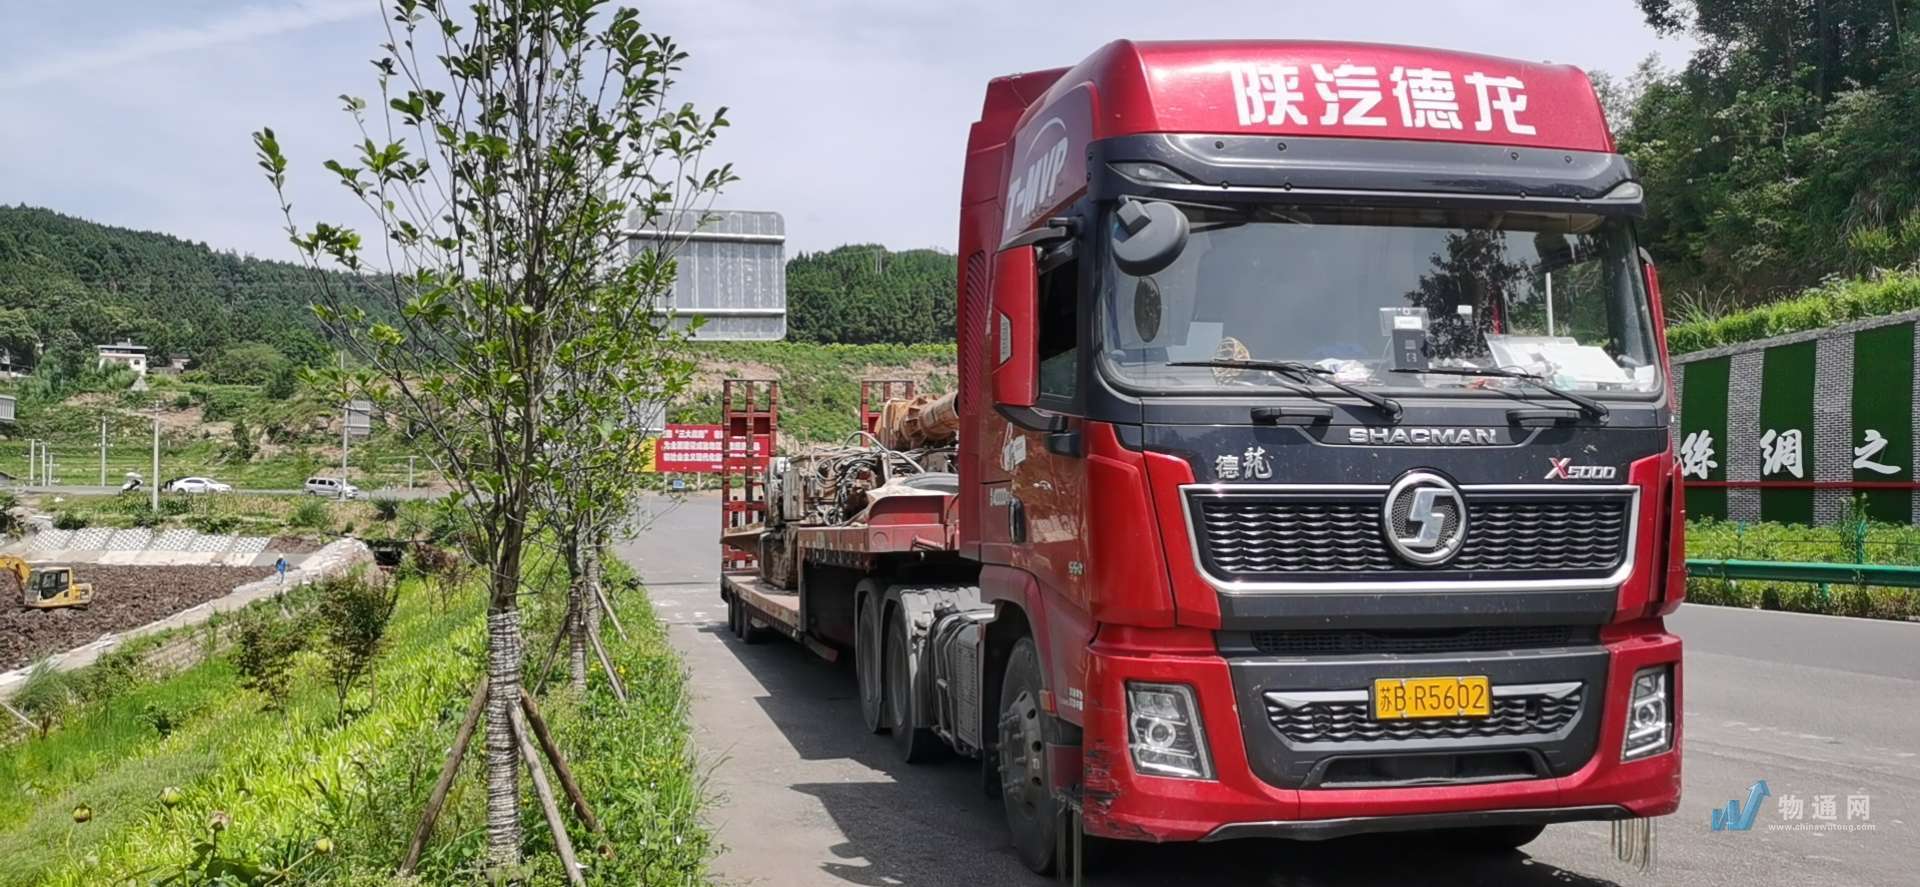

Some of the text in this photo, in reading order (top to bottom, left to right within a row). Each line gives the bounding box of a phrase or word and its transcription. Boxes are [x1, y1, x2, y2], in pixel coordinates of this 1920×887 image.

[1230, 63, 1537, 136] 陕汽德龙
[1349, 427, 1497, 444] SHACMAN
[1543, 457, 1617, 479] X5000
